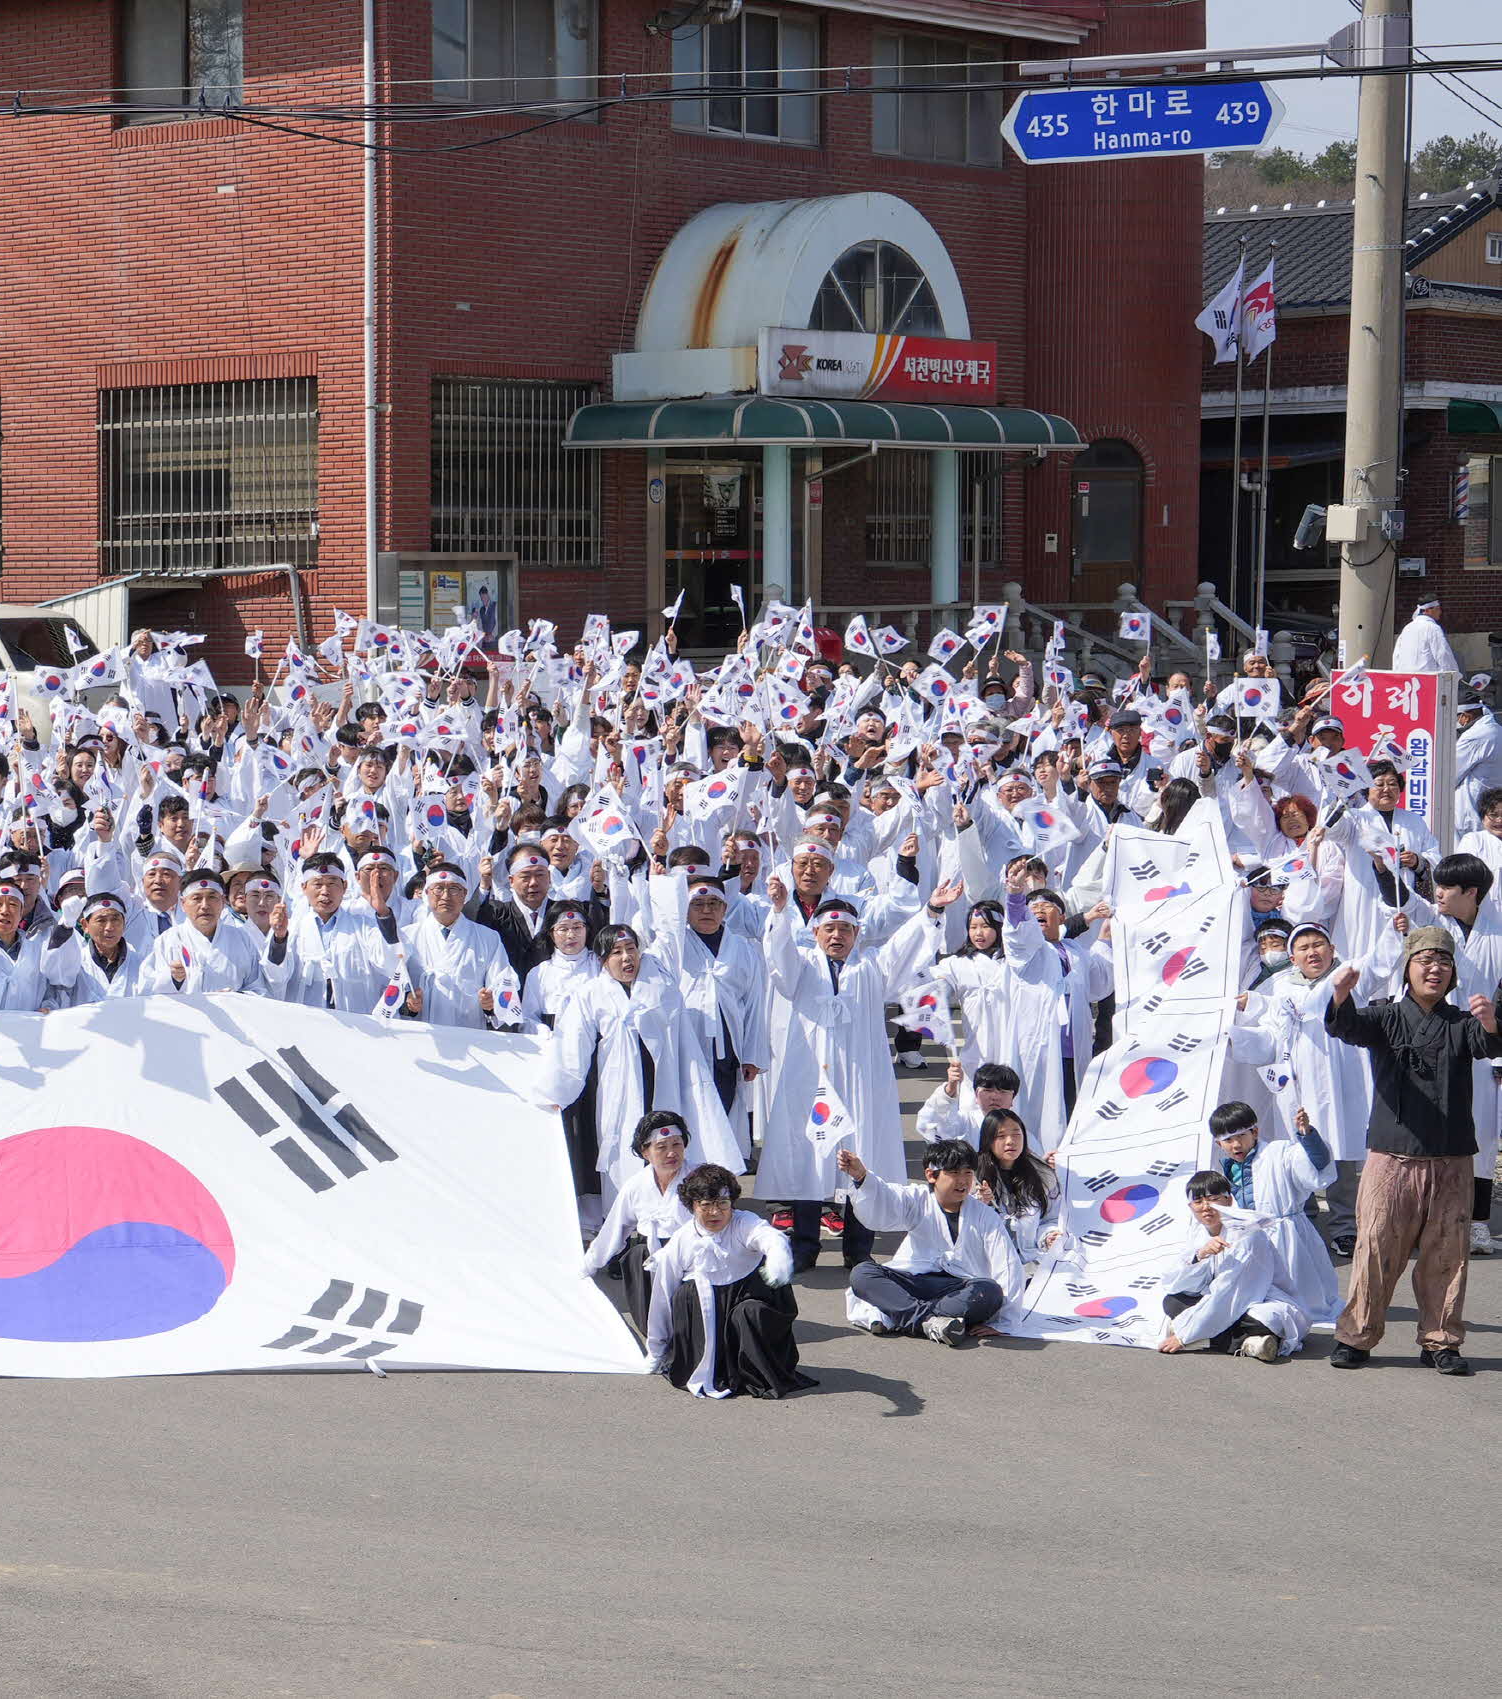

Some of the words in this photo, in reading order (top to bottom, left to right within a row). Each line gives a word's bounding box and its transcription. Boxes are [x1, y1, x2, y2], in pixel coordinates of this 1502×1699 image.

[1026, 114, 1070, 138] 435
[1091, 89, 1193, 126] 한마로
[1215, 101, 1260, 125] 439
[1094, 129, 1192, 150] Hanma-ro
[816, 358, 842, 372] KOREA
